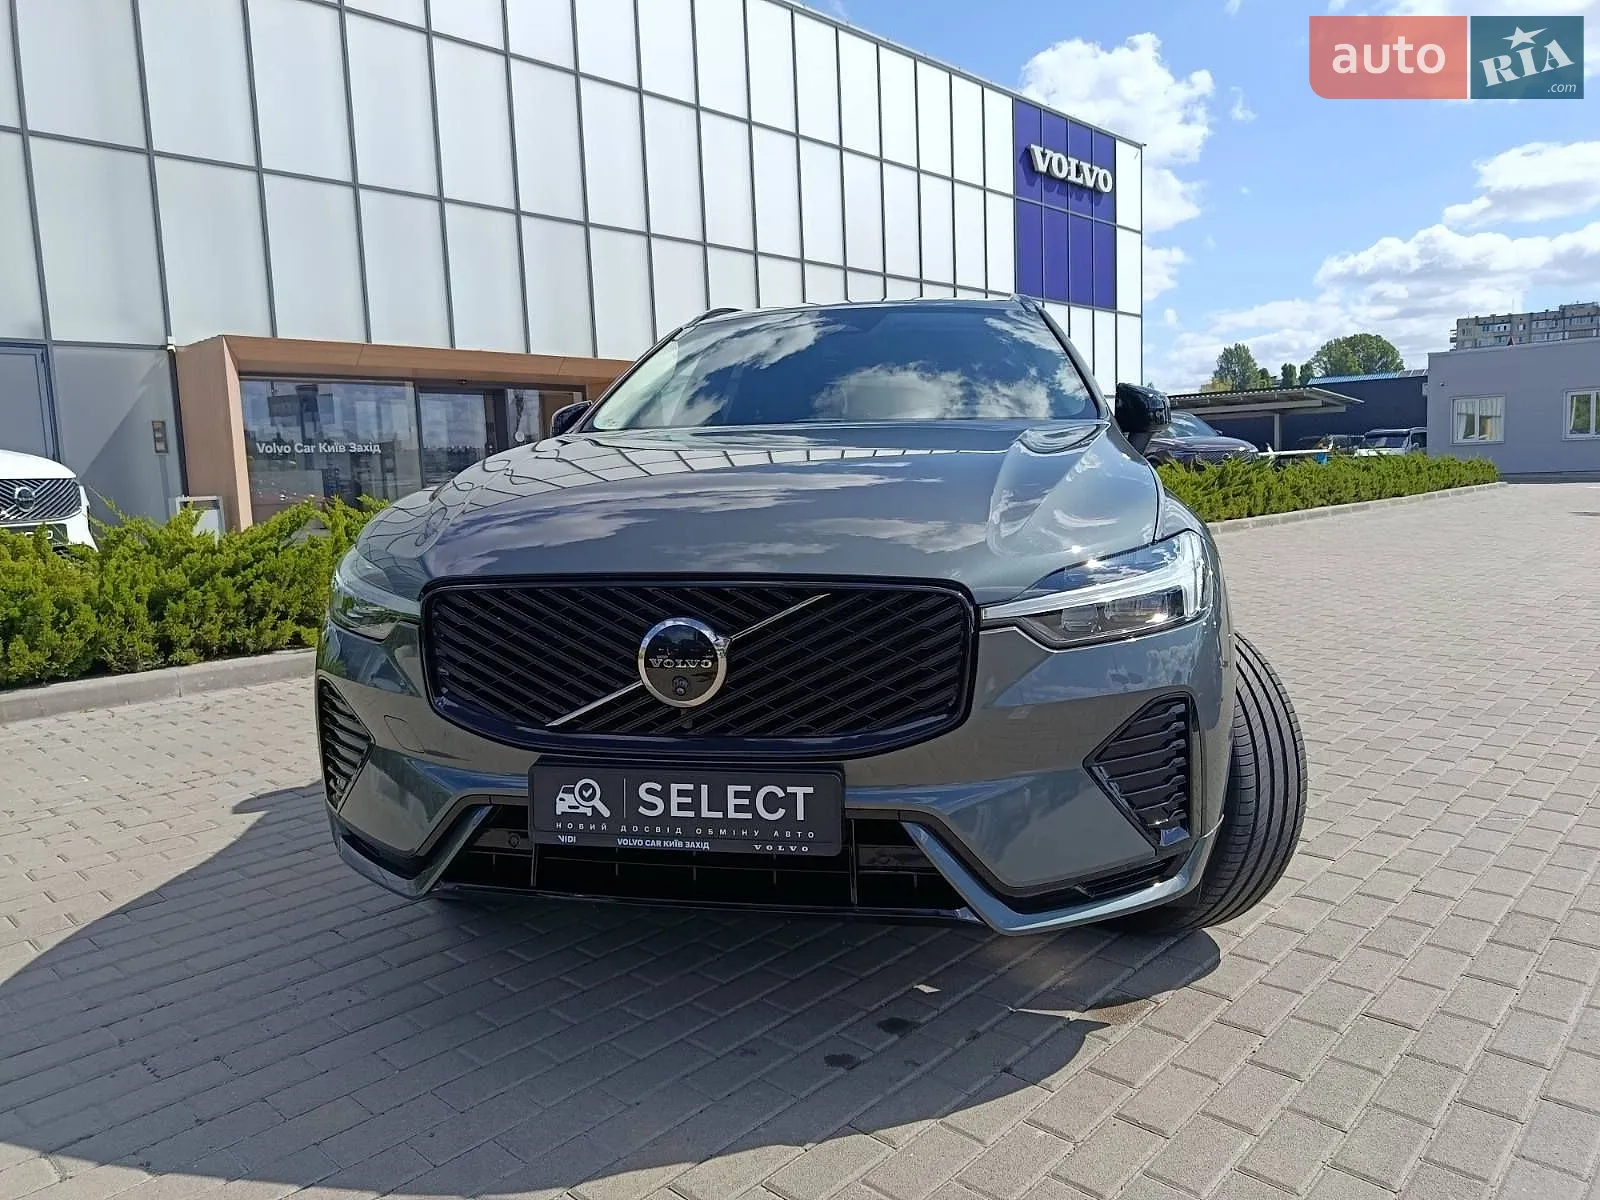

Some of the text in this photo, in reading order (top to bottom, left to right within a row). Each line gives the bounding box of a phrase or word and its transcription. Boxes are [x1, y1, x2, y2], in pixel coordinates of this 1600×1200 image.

[1029, 144, 1112, 192] VOLVO
[256, 442, 381, 455] Volvo Car Київ Захід
[649, 659, 713, 668] VOLVO
[638, 782, 814, 820] SELECT
[556, 822, 814, 839] НОВИЙ ДОСВІД ОБМІНУ АВТО
[617, 838, 710, 850] VOLVO CAR КИЇВ ЗАХІД
[752, 844, 809, 852] VOLVO
